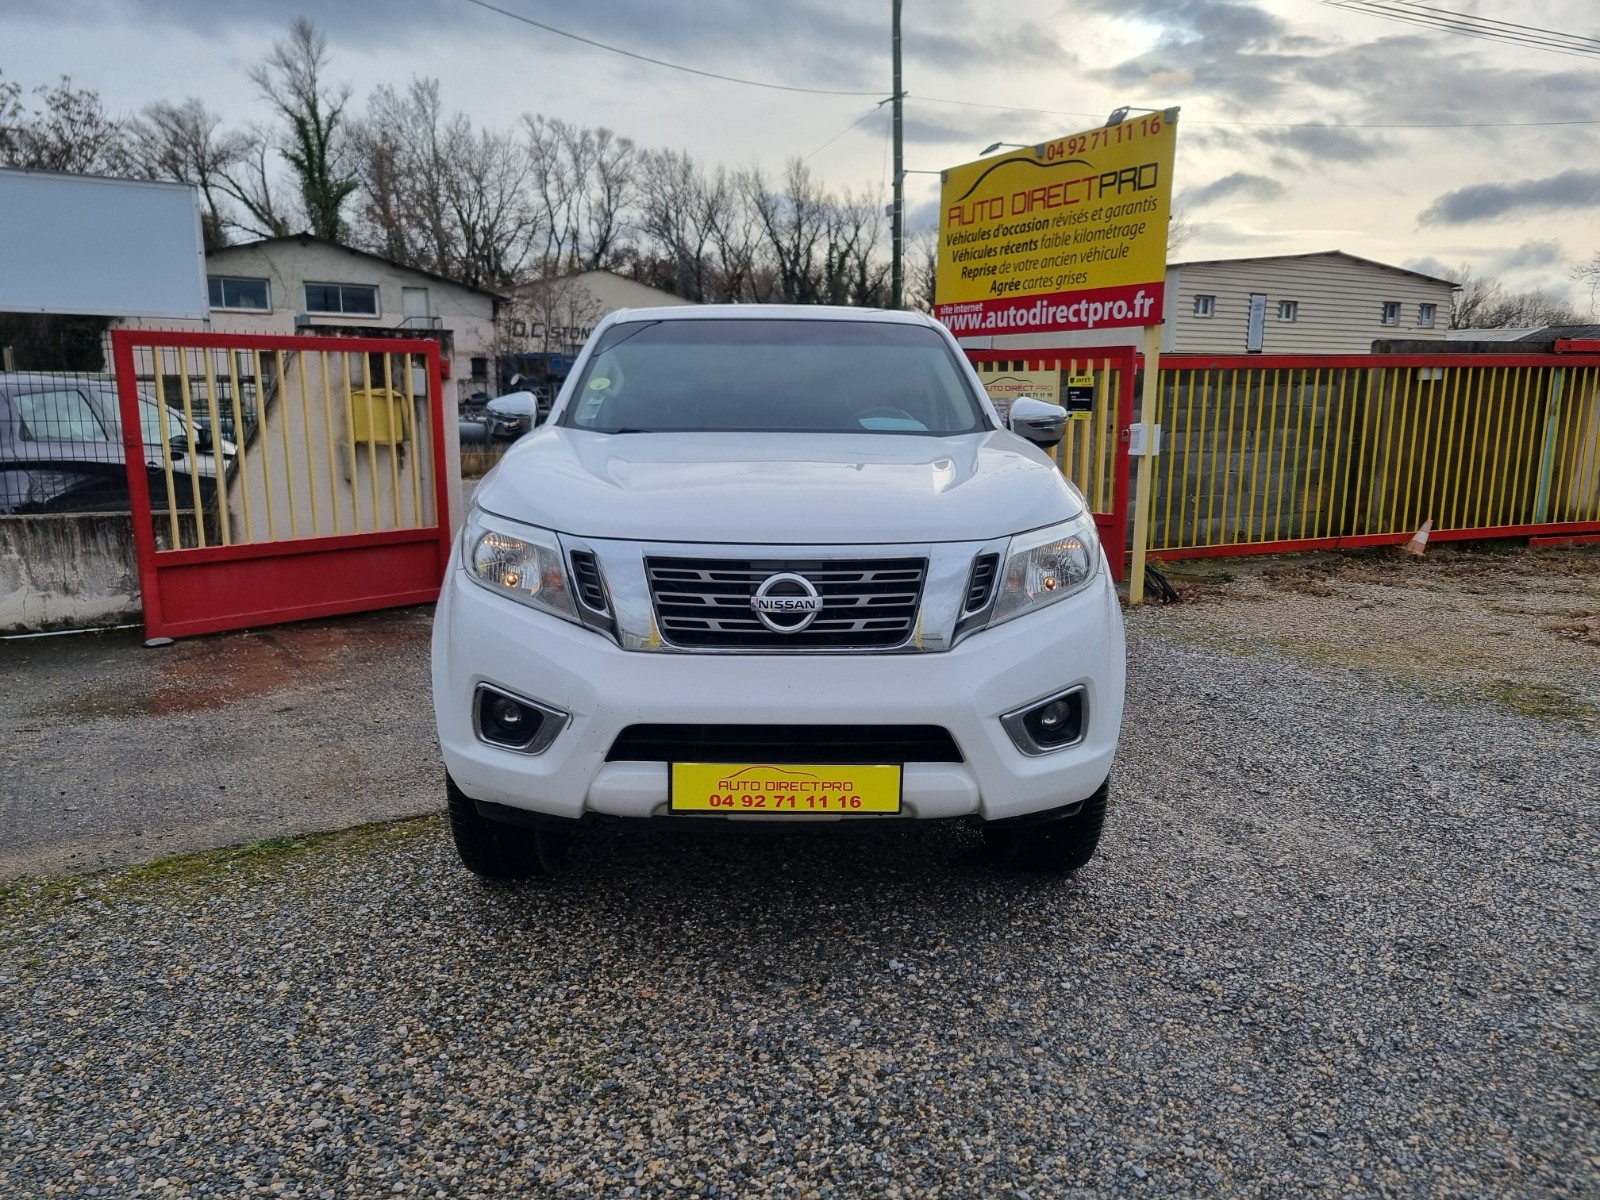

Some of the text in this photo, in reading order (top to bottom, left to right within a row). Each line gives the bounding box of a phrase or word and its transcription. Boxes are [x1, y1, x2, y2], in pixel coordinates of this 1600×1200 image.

[1047, 116, 1161, 160] 04 92 71 11 16
[947, 195, 1158, 247] Véhicules d'occasion révisés et garantis
[948, 197, 1004, 228] AUTO
[952, 222, 1146, 263] Véhicules récents faible kilométrage
[961, 242, 1130, 281] Reprise de votre ancien véhicule
[990, 270, 1088, 296] Agrée cartes grises
[940, 302, 983, 315] site internet
[940, 290, 1154, 330] www.autodirectpro.fr
[550, 326, 595, 340] STON
[758, 600, 815, 609] NISSAN
[718, 781, 761, 791] AUTO
[709, 794, 862, 808] 04 92 71 11 16
